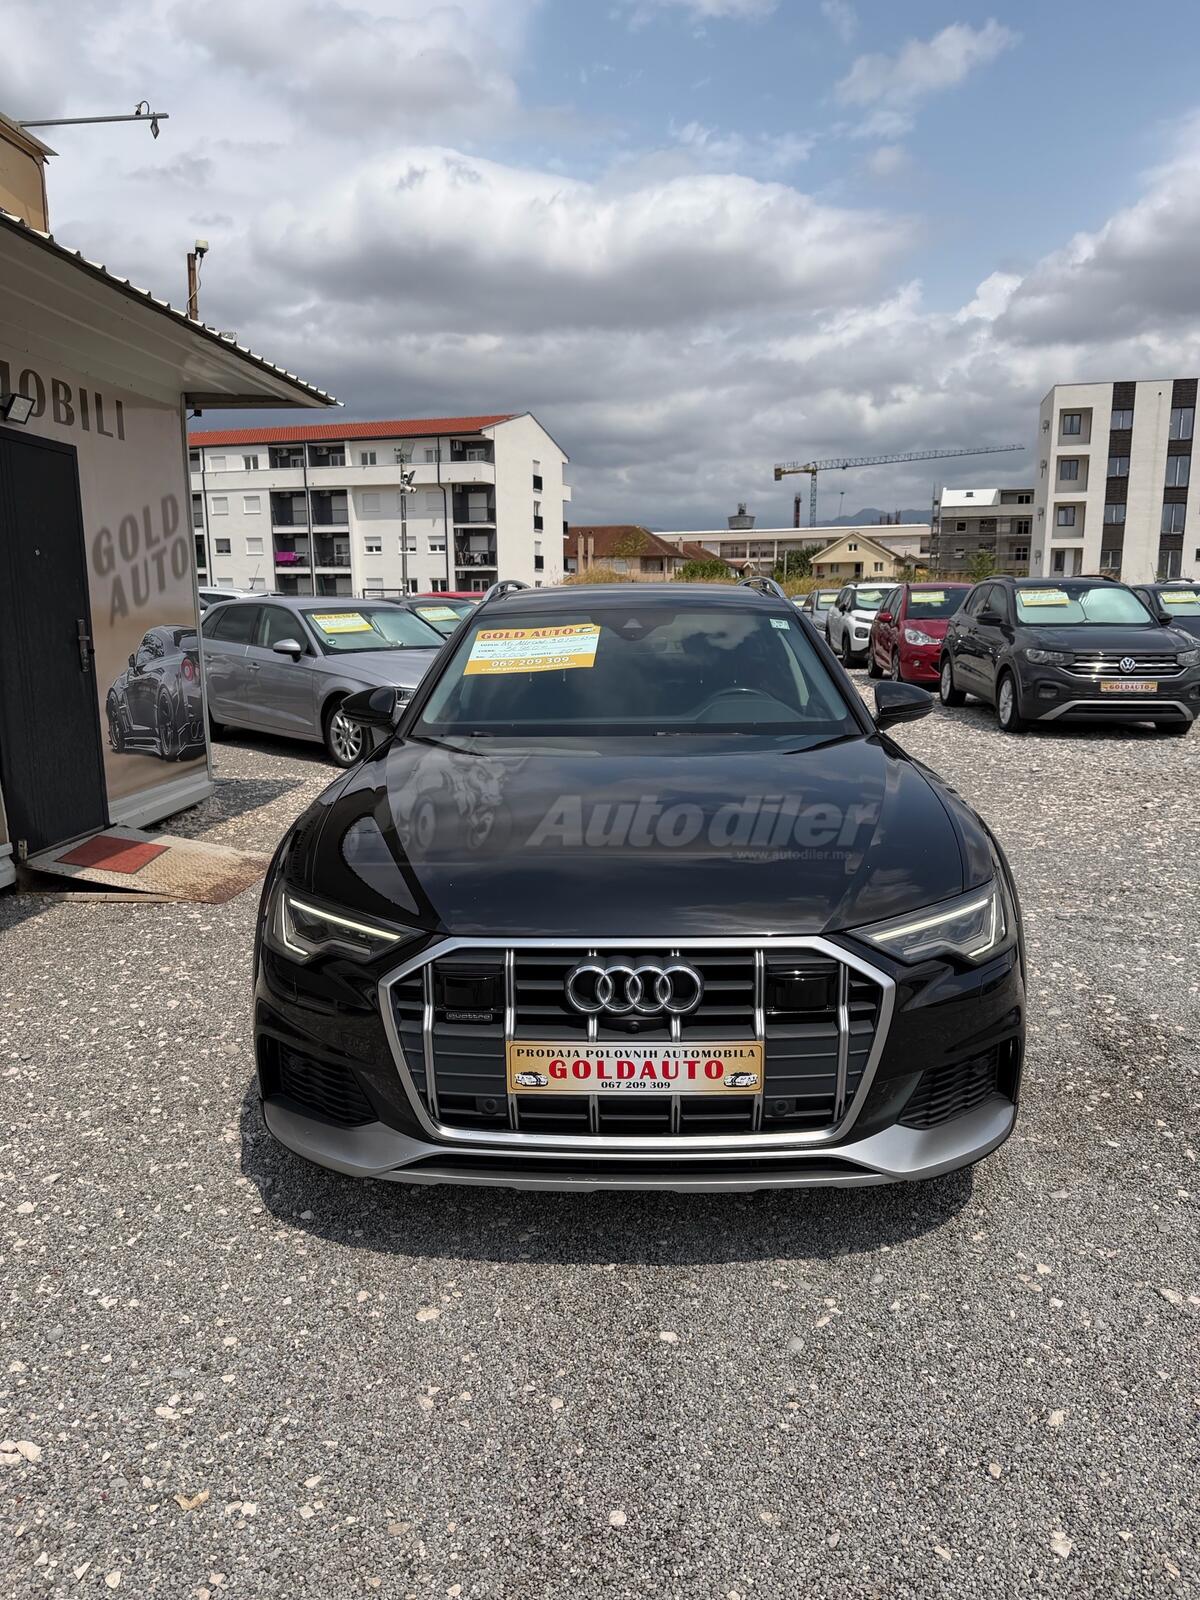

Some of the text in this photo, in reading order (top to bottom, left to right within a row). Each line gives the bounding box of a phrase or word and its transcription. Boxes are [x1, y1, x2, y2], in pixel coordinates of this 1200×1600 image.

[0, 360, 125, 440] OBILI
[92, 493, 180, 577] GOLD
[109, 536, 189, 627] AUTO
[481, 628, 574, 639] GOLD AUTO
[546, 656, 570, 664] 309
[516, 1048, 756, 1059] PRODAJA POLOVNIH AUTOMOBILA
[548, 1059, 724, 1080] GOLDAUTO
[601, 1081, 671, 1089] 067 209 309
